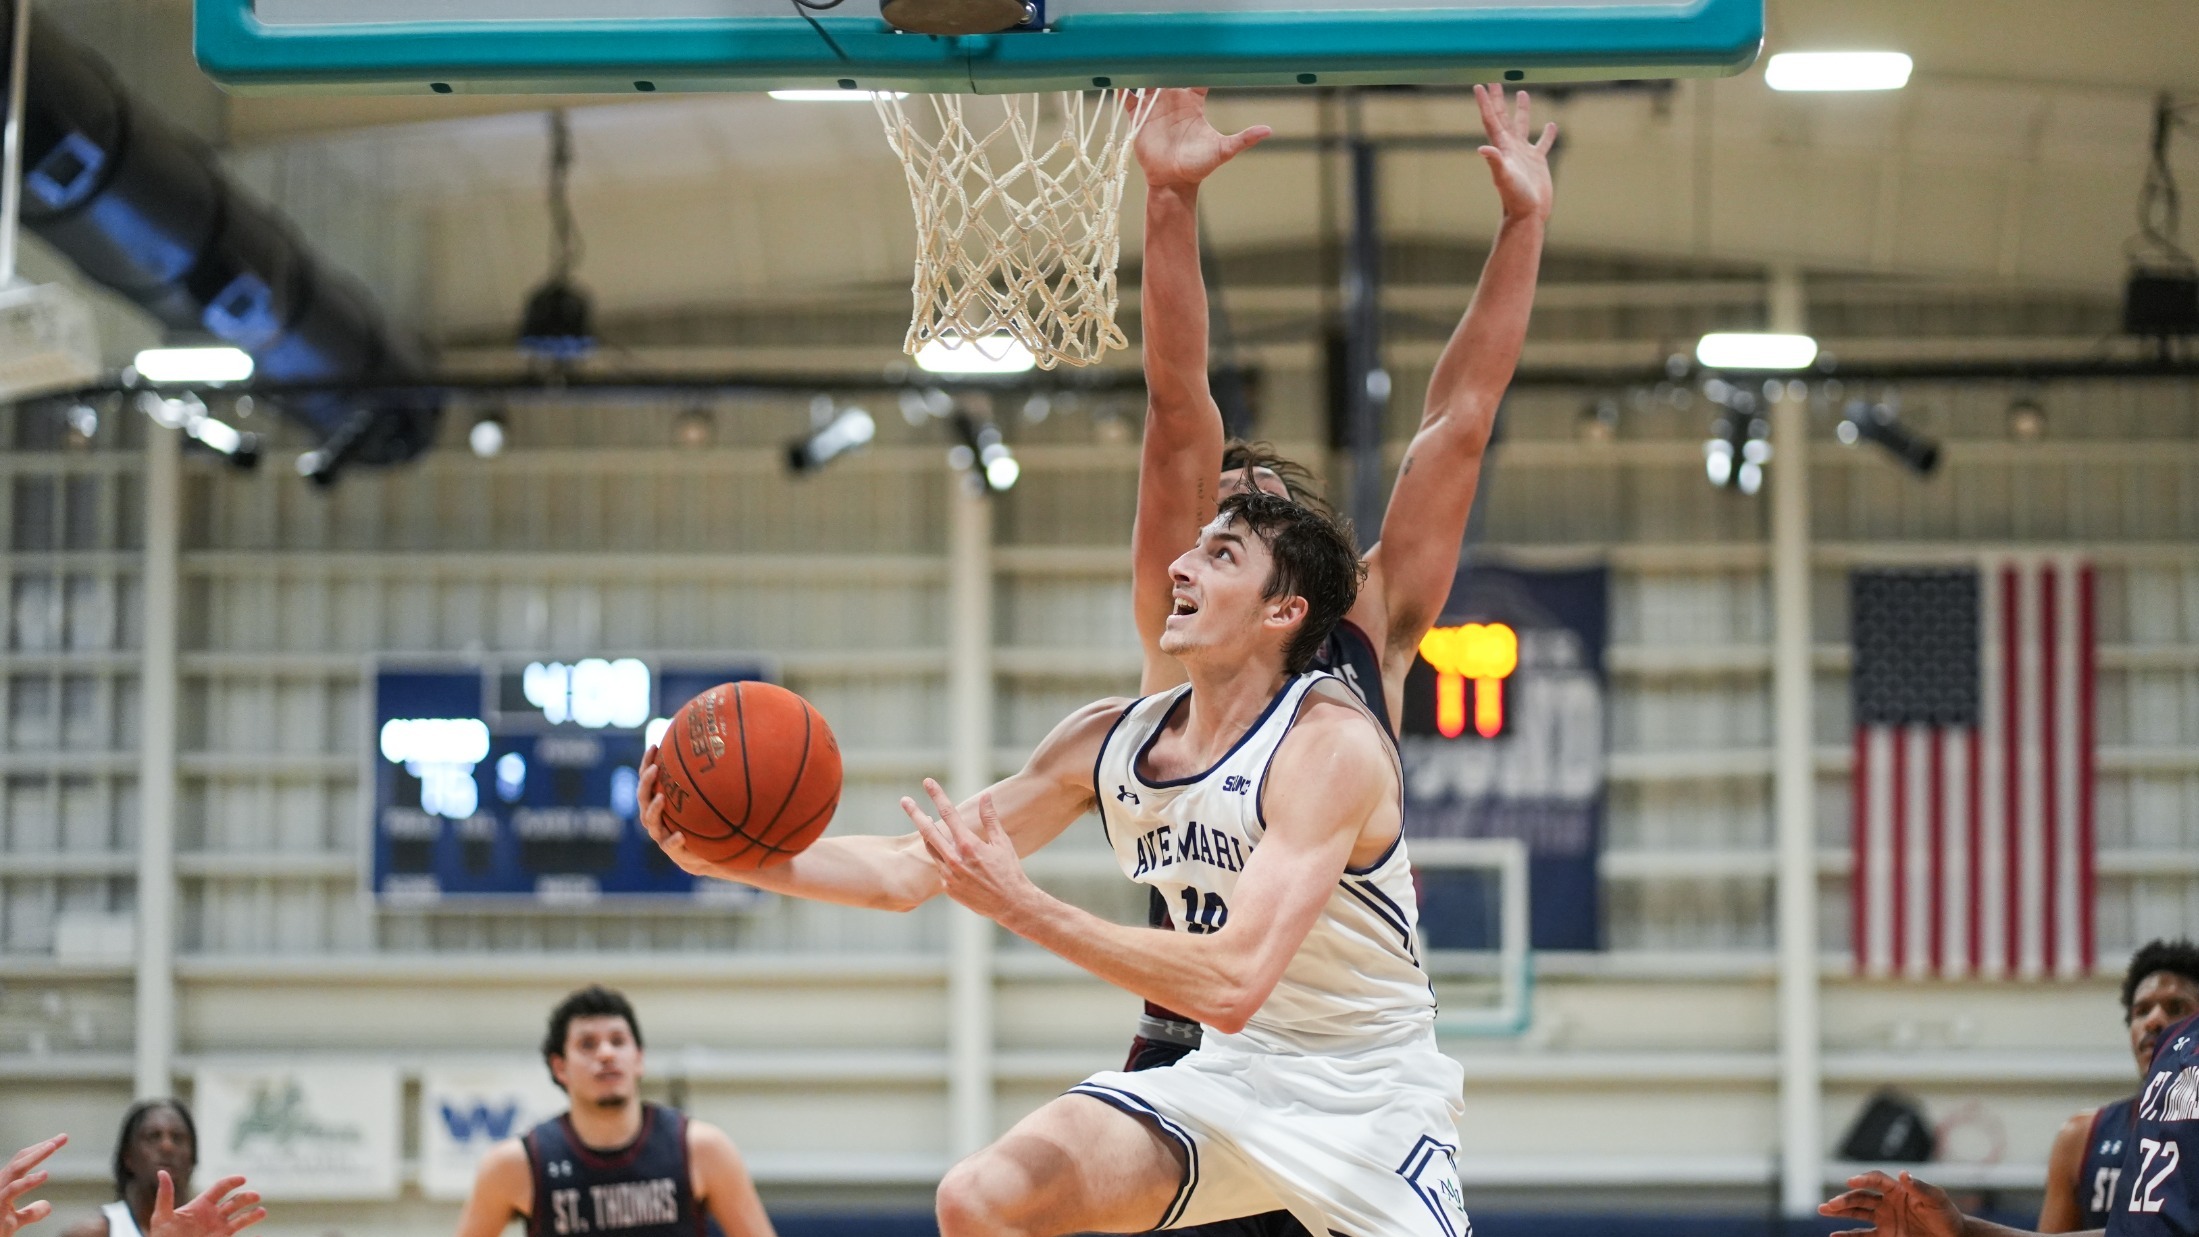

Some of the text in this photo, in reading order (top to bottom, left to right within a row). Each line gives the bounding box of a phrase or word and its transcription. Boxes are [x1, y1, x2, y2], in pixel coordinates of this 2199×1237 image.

[1133, 821, 1254, 879] AVE MARI
[1181, 885, 1229, 935] 10
[2128, 1137, 2180, 1213] 22
[551, 1187, 589, 1236] ST.
